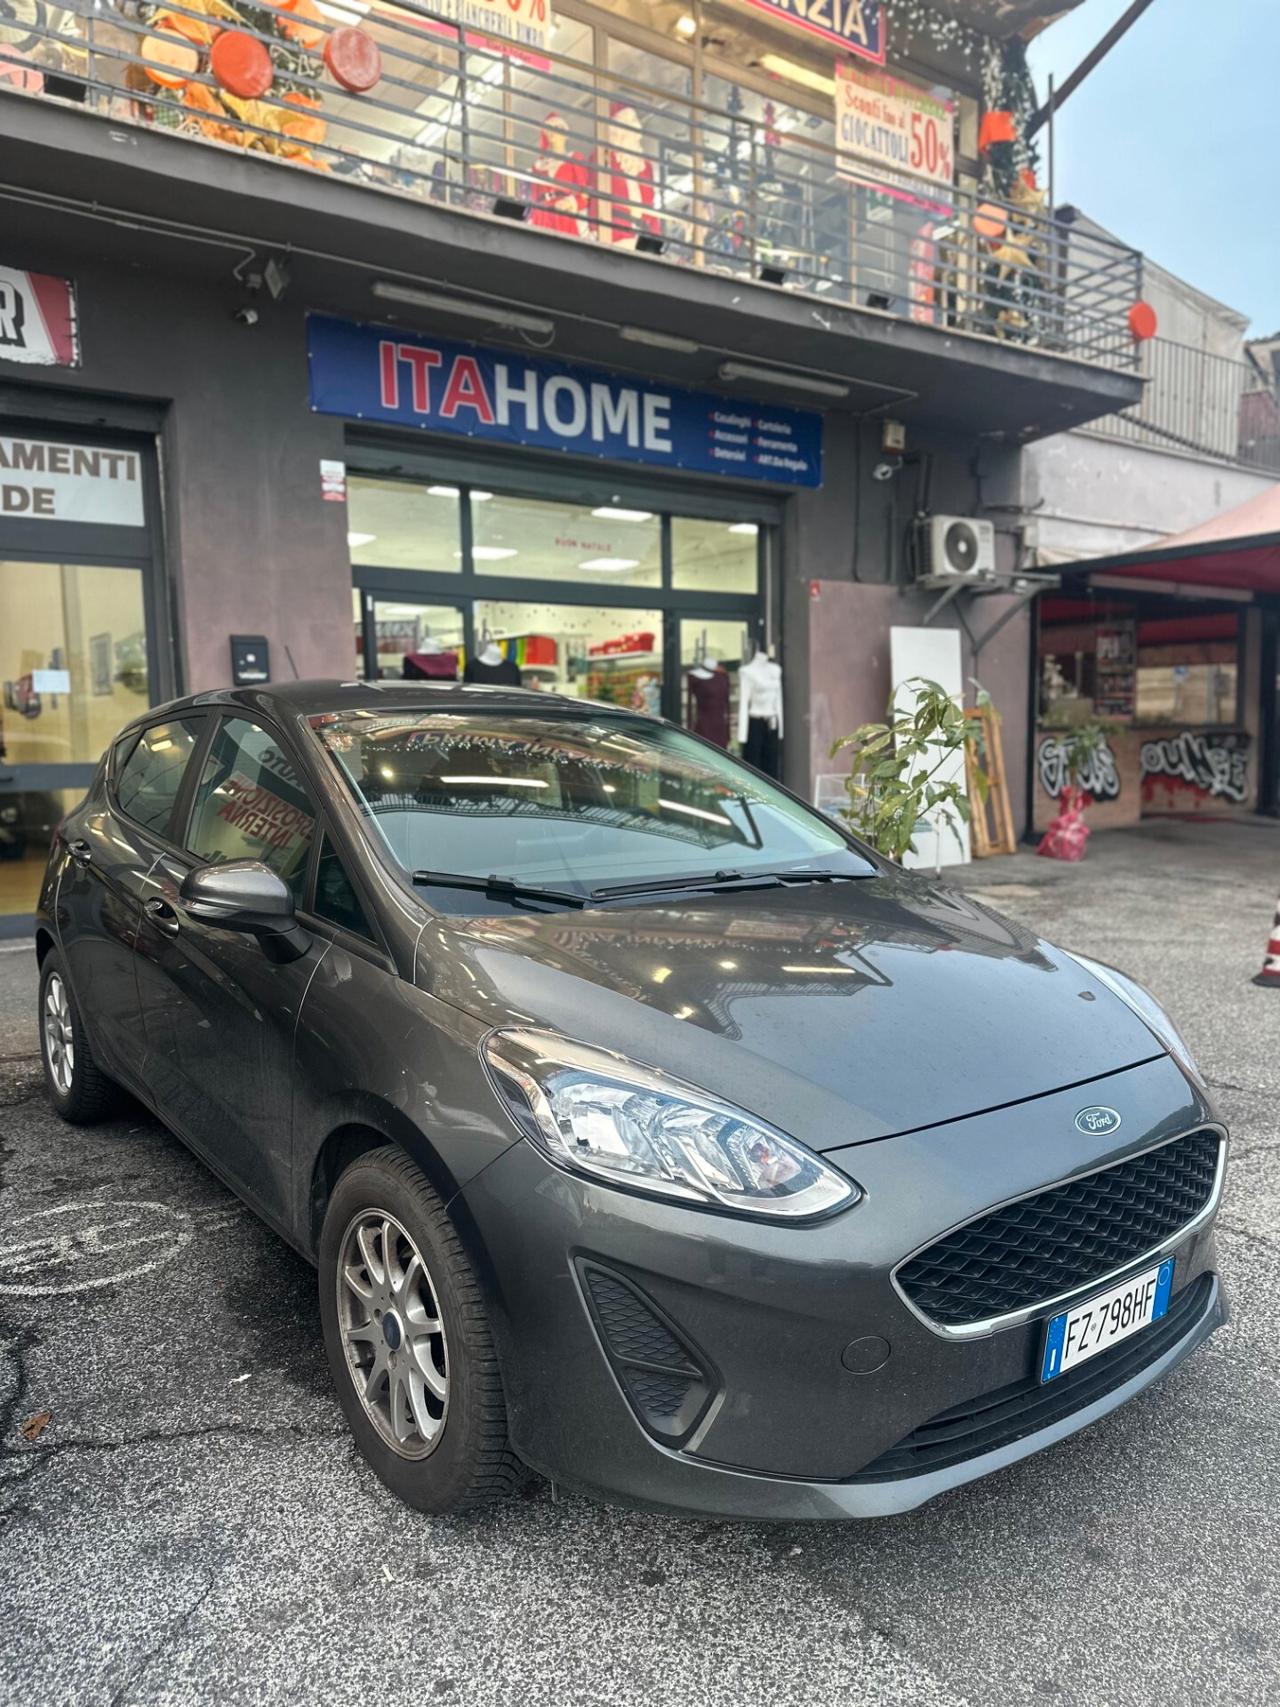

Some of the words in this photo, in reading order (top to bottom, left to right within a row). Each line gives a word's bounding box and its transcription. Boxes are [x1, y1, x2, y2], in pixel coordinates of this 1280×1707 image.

[841, 112, 909, 164] GIOCATTOLI
[911, 112, 951, 181] 50%
[379, 340, 672, 453] ITAHOME
[2, 484, 55, 515] DE
[1086, 1112, 1113, 1130] Ford
